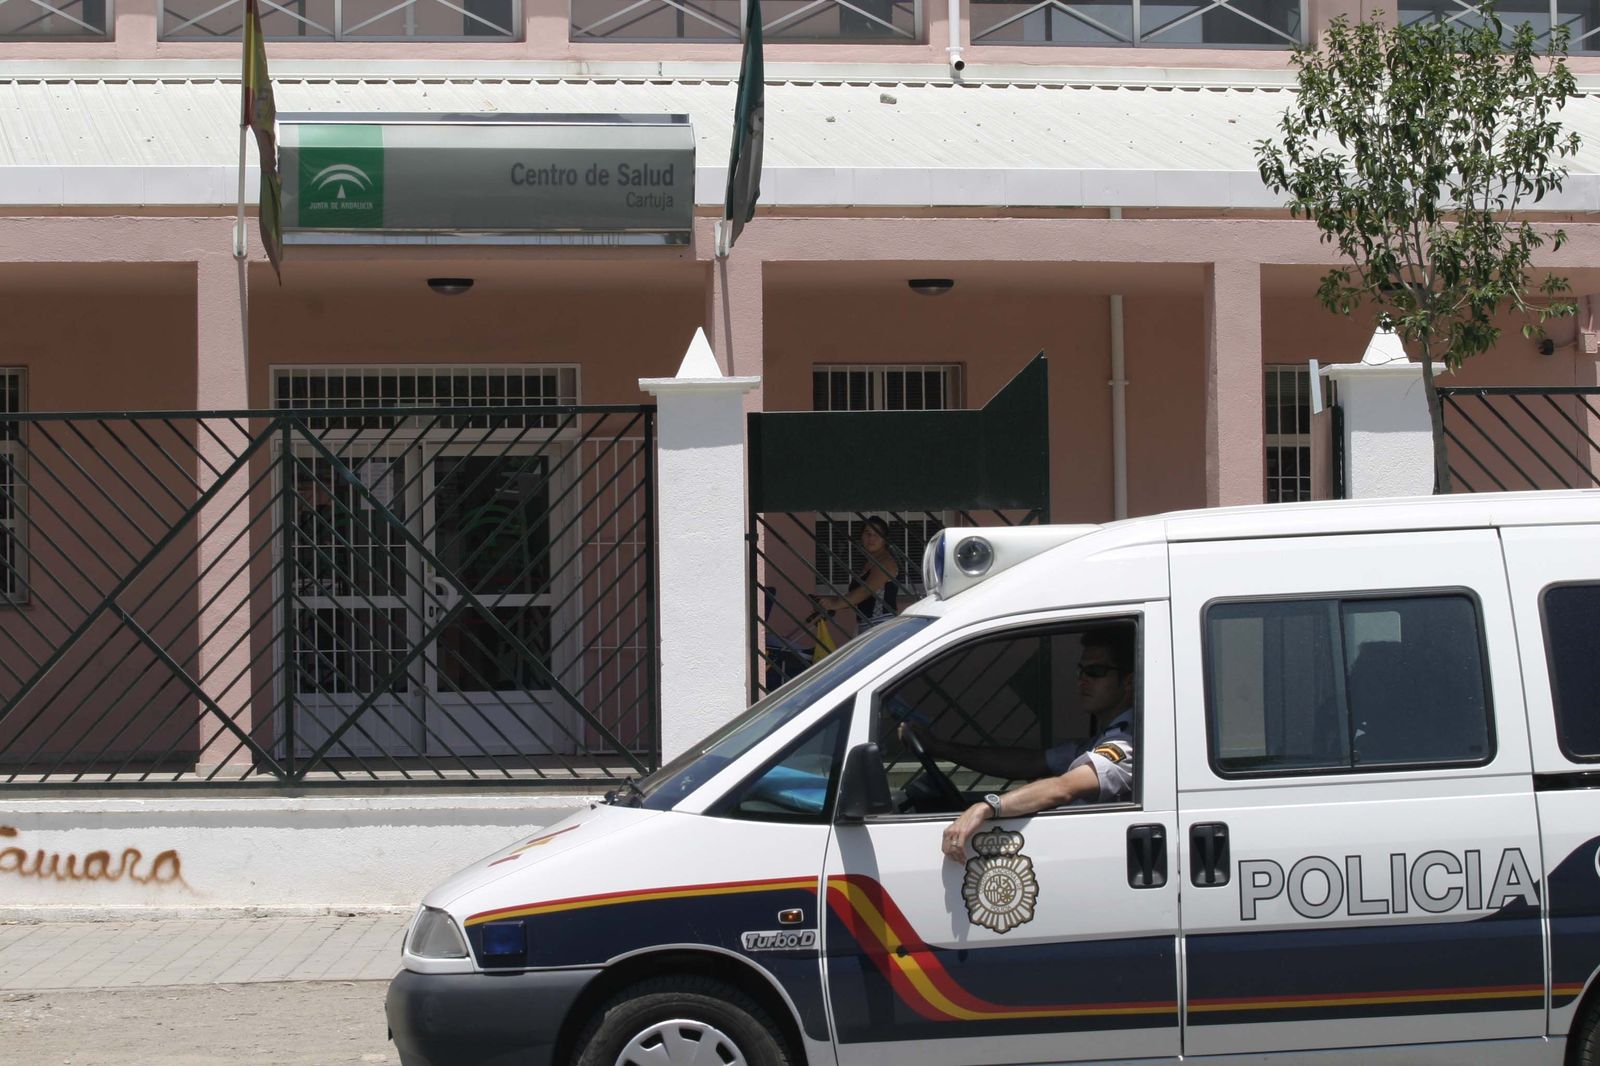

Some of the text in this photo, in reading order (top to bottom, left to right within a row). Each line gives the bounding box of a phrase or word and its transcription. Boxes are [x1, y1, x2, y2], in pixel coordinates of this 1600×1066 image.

[510, 162, 675, 187] Centro de Salud
[625, 191, 675, 211] Cartuja
[1238, 847, 1541, 921] POLICIA
